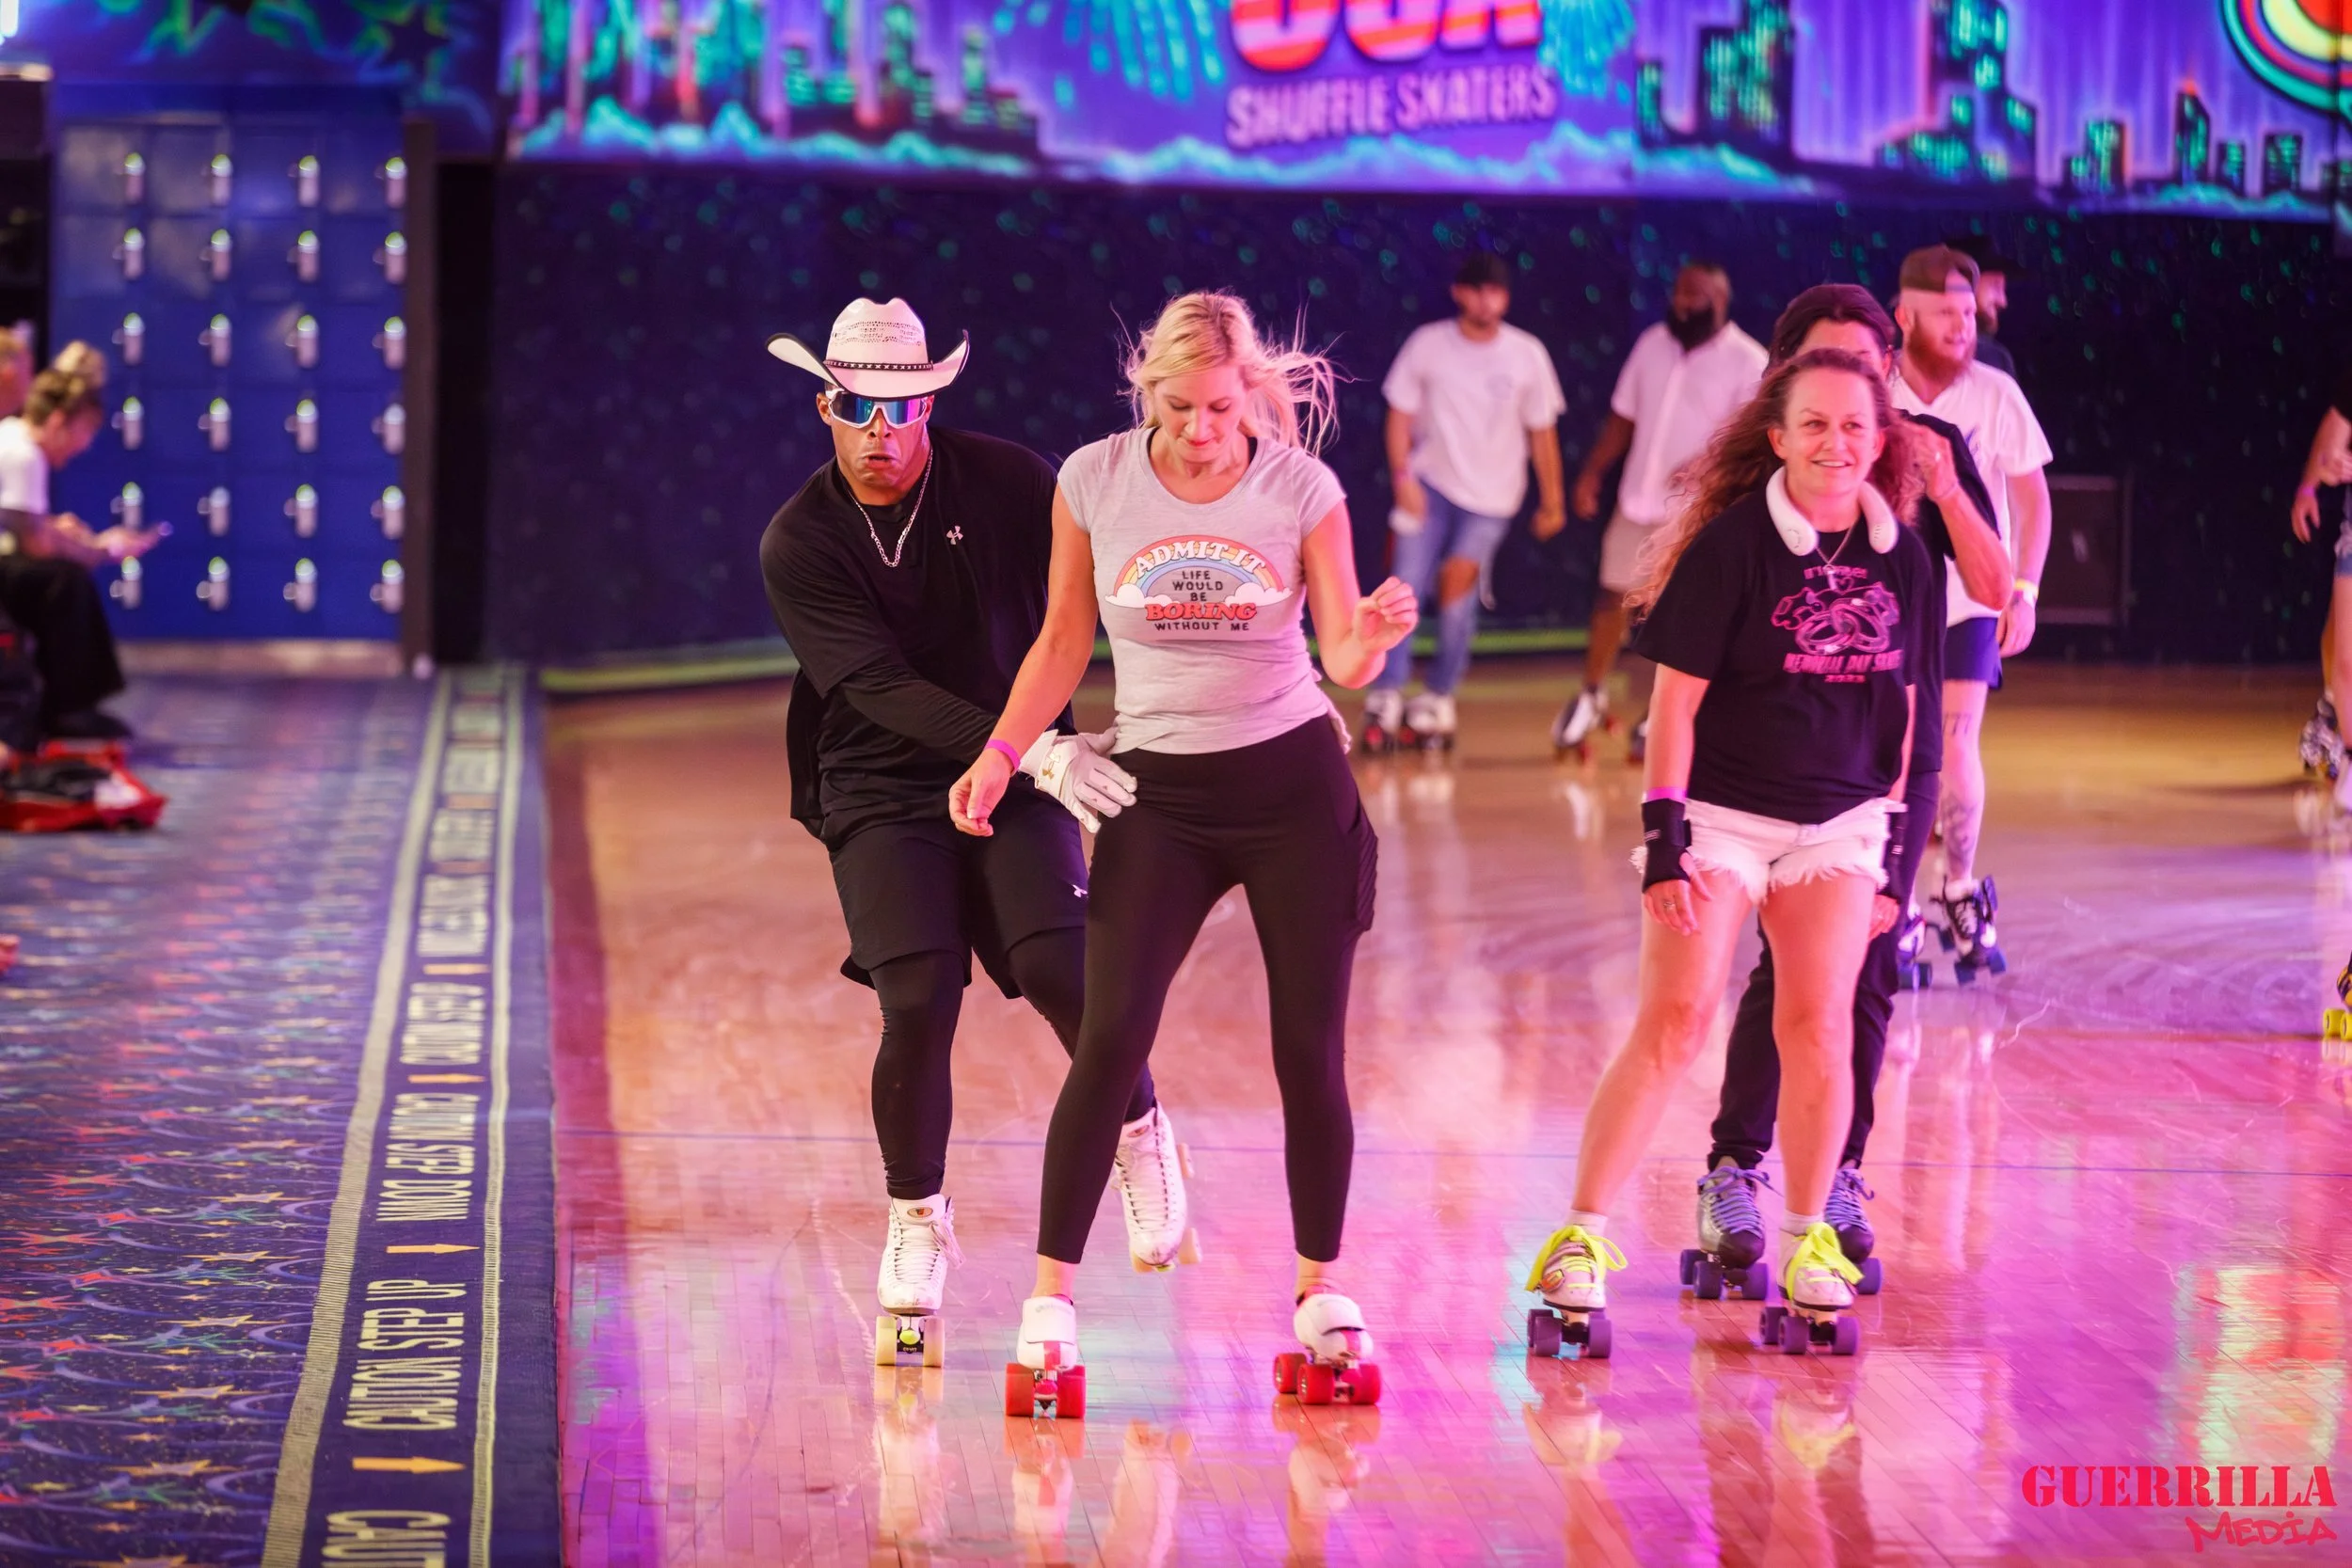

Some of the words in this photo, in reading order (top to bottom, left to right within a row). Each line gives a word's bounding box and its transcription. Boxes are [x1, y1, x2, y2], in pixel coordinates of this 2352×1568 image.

[1226, 75, 1389, 149] SHUFFLE
[1395, 65, 1557, 130] SKATERS
[1136, 541, 1229, 578] ADMIT
[1232, 548, 1266, 575] IT
[1181, 570, 1212, 580] LIFE
[1171, 580, 1224, 591] WOULD
[1189, 592, 1208, 602] BE
[1144, 602, 1258, 621] BORING
[1153, 622, 1220, 631] WITHOUT
[1230, 622, 1249, 631] ME
[388, 1092, 481, 1141] CAUTION
[385, 1142, 475, 1175] STEP
[376, 1180, 472, 1222] DOWN
[365, 1278, 468, 1302] UP
[357, 1307, 466, 1351] STEP
[342, 1355, 463, 1431] CAUTION
